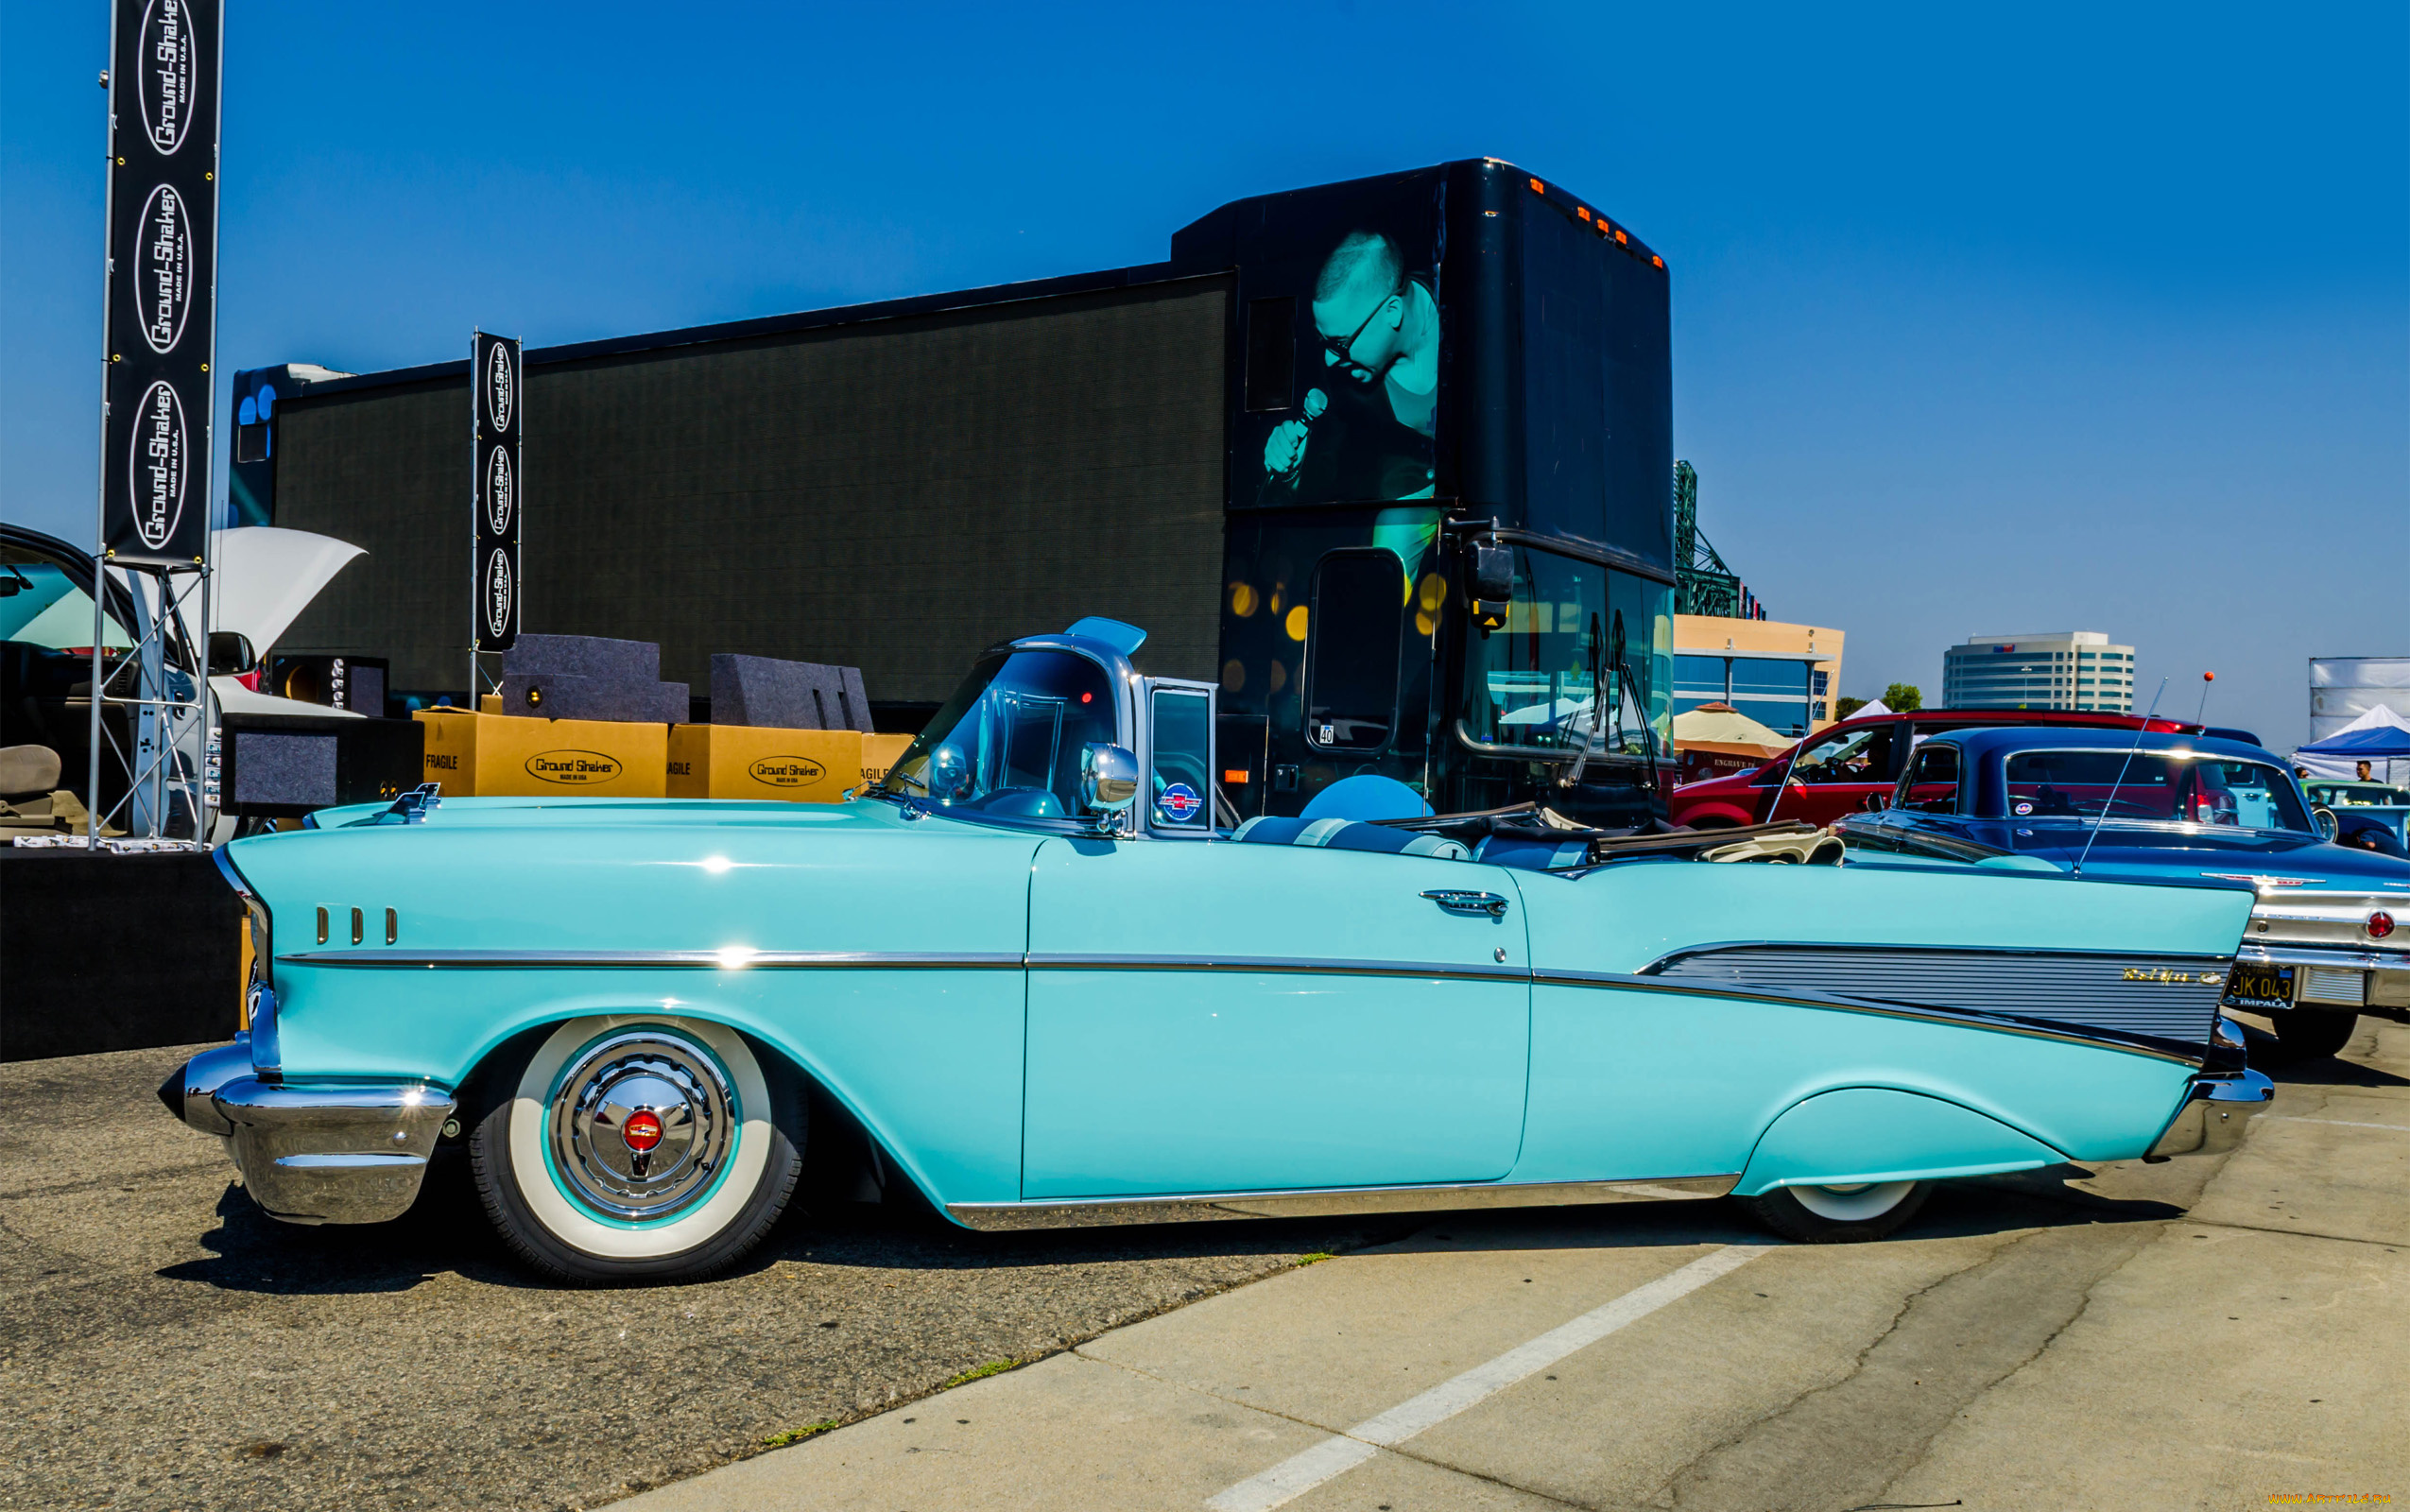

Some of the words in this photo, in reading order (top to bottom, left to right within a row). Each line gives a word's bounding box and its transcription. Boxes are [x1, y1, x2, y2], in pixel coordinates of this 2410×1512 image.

[155, 0, 179, 146] Ground-Shake
[180, 64, 186, 75] IN
[176, 233, 184, 260] U.S.A.
[151, 189, 176, 344] Ground-Shaker
[176, 263, 183, 272] IN
[494, 345, 505, 427] Ground-Shaker
[171, 429, 180, 456] U.S.A.
[145, 386, 172, 540] Ground-Shaker
[170, 458, 178, 469] IN
[169, 471, 178, 498] MADE
[494, 448, 505, 529] Ground-Shaker
[492, 551, 504, 632] Ground-Shaker
[1320, 730, 1333, 743] 40
[425, 754, 457, 770] FRAGILE
[536, 759, 574, 772] Ground
[577, 760, 612, 773] Shaker
[666, 762, 691, 776] AGILE
[757, 764, 787, 776] Ground
[789, 765, 818, 777] Shaker
[860, 768, 889, 780] AGIL
[2231, 976, 2256, 996] JK
[2261, 978, 2291, 999] 043
[2239, 998, 2287, 1008] IMPALA
